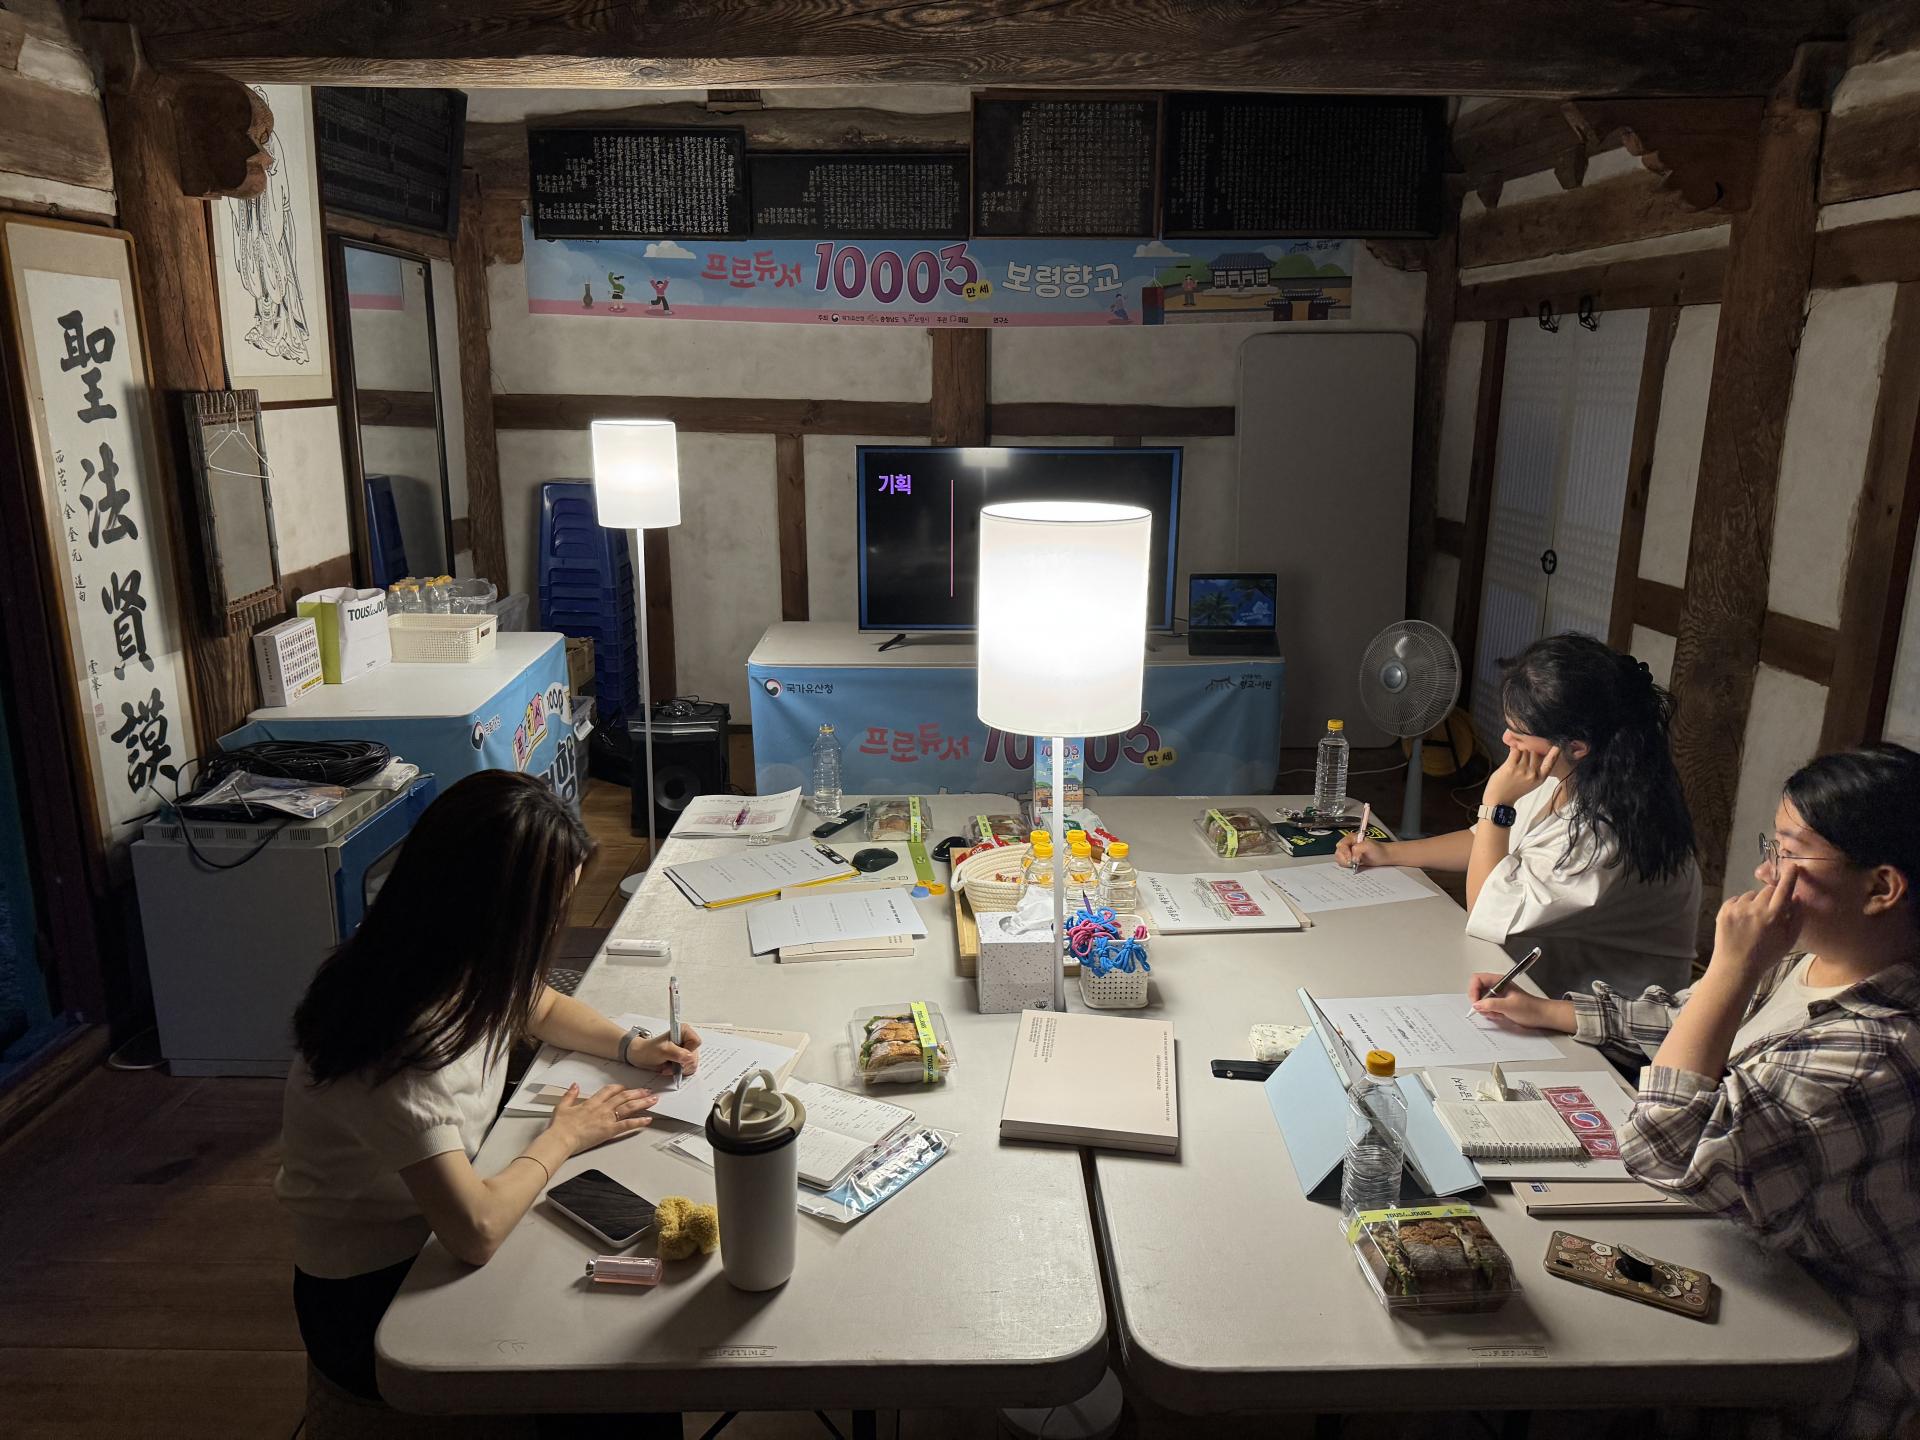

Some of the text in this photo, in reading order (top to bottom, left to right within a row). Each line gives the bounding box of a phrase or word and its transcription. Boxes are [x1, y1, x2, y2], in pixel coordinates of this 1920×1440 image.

[700, 242, 979, 304] 프로듀서 10003
[1000, 259, 1124, 299] 보령향교
[993, 316, 1009, 324] 연구소
[878, 473, 912, 495] 기획
[347, 605, 370, 622] TOUS
[786, 682, 834, 695] 국가유산청
[859, 722, 971, 763] 프로듀서
